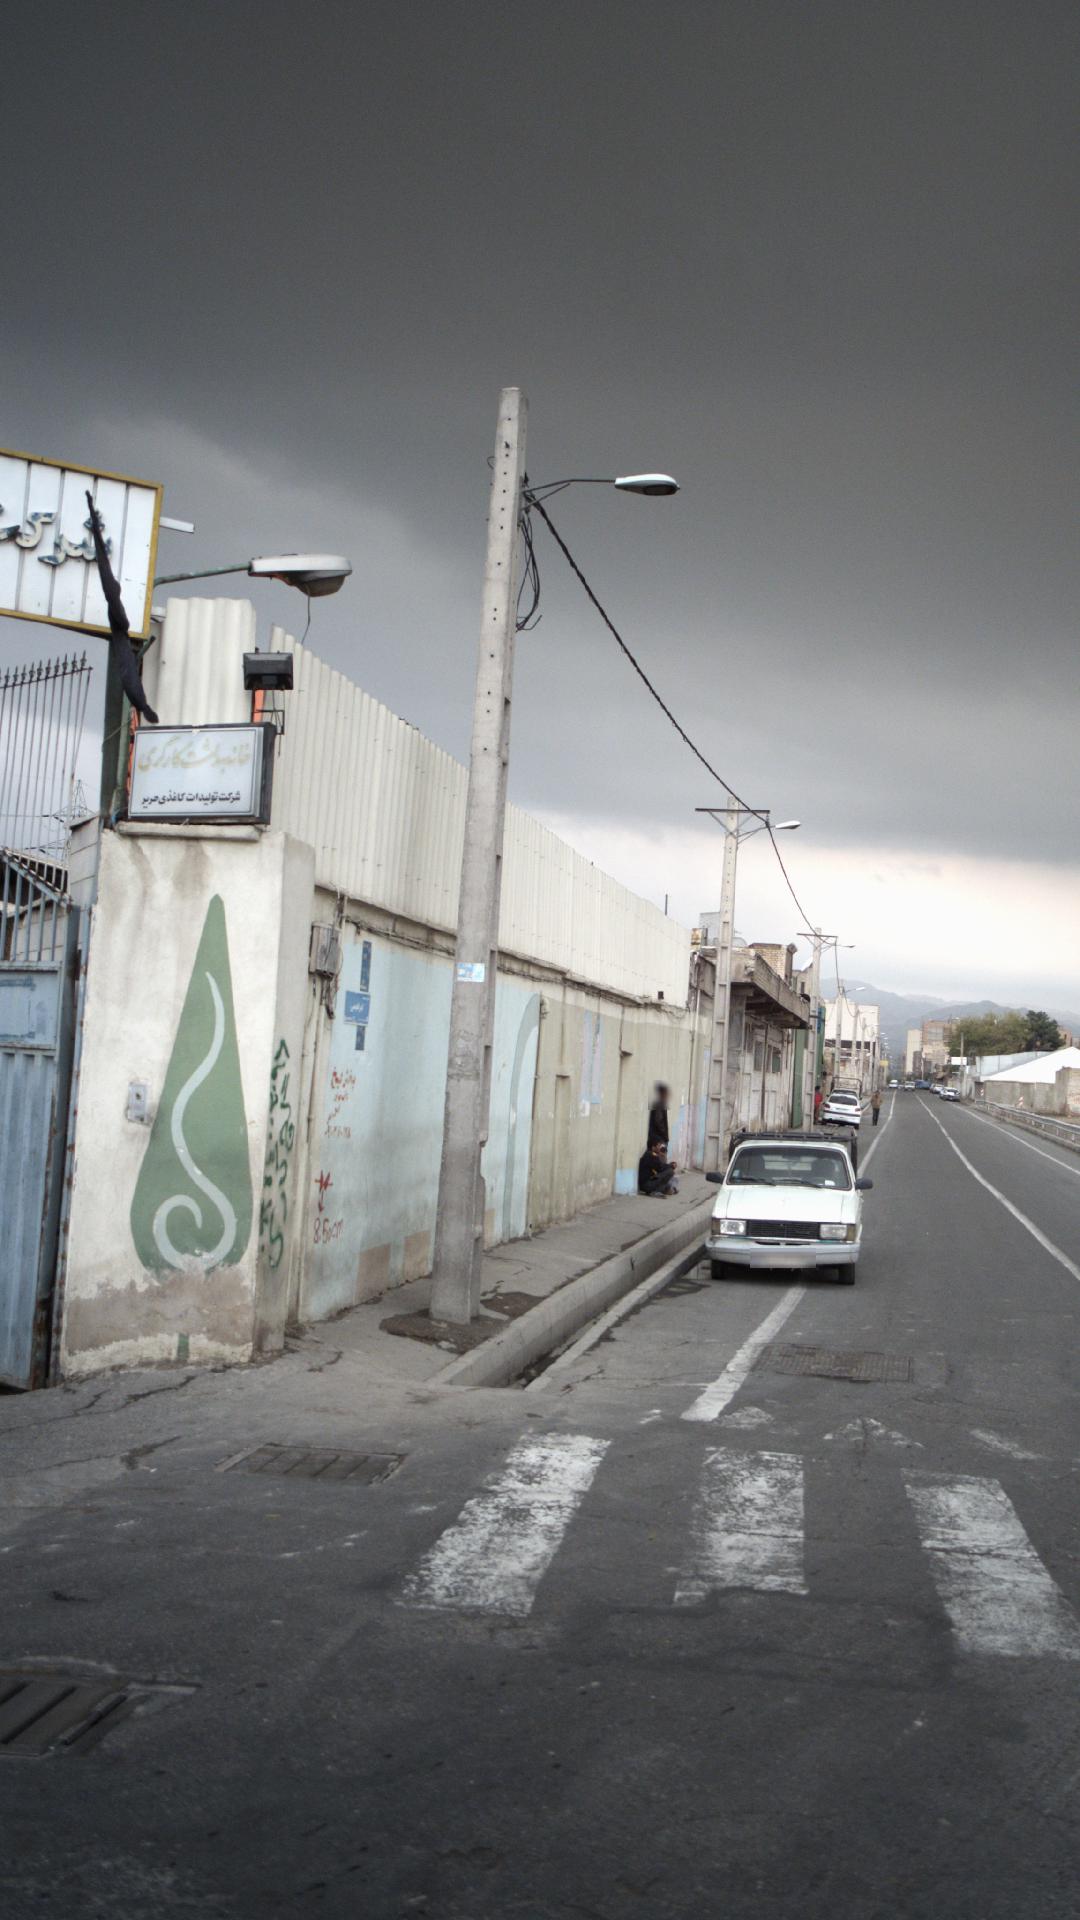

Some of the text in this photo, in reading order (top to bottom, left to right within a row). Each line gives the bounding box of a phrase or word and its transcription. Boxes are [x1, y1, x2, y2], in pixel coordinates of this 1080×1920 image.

[159, 790, 186, 805] کاغذی
[186, 791, 218, 806] تولیدات
[218, 790, 241, 804] شرکت
